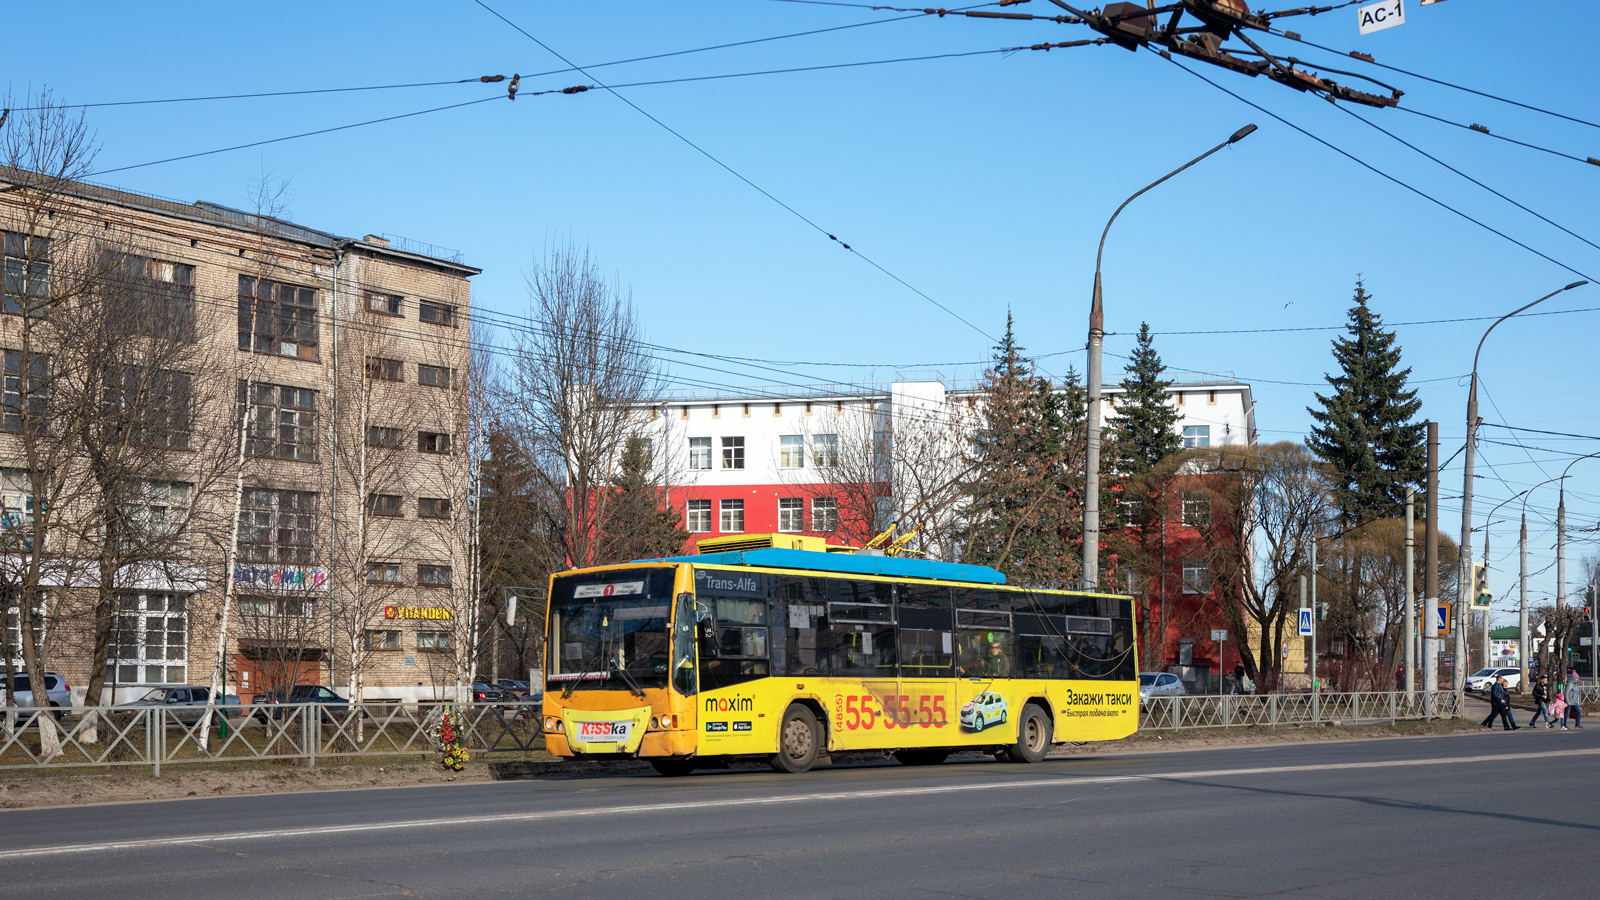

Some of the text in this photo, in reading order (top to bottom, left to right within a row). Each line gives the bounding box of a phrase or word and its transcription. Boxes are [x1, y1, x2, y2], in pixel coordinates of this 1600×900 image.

[1361, 3, 1402, 27] АС-1
[606, 585, 612, 596] 1
[706, 576, 757, 591] Trans-Alfa
[706, 693, 753, 712] maxim
[1066, 689, 1132, 706] Закажи такси
[835, 694, 844, 733] (4855)
[1066, 708, 1089, 718] Быстрая
[1089, 708, 1107, 717] подача
